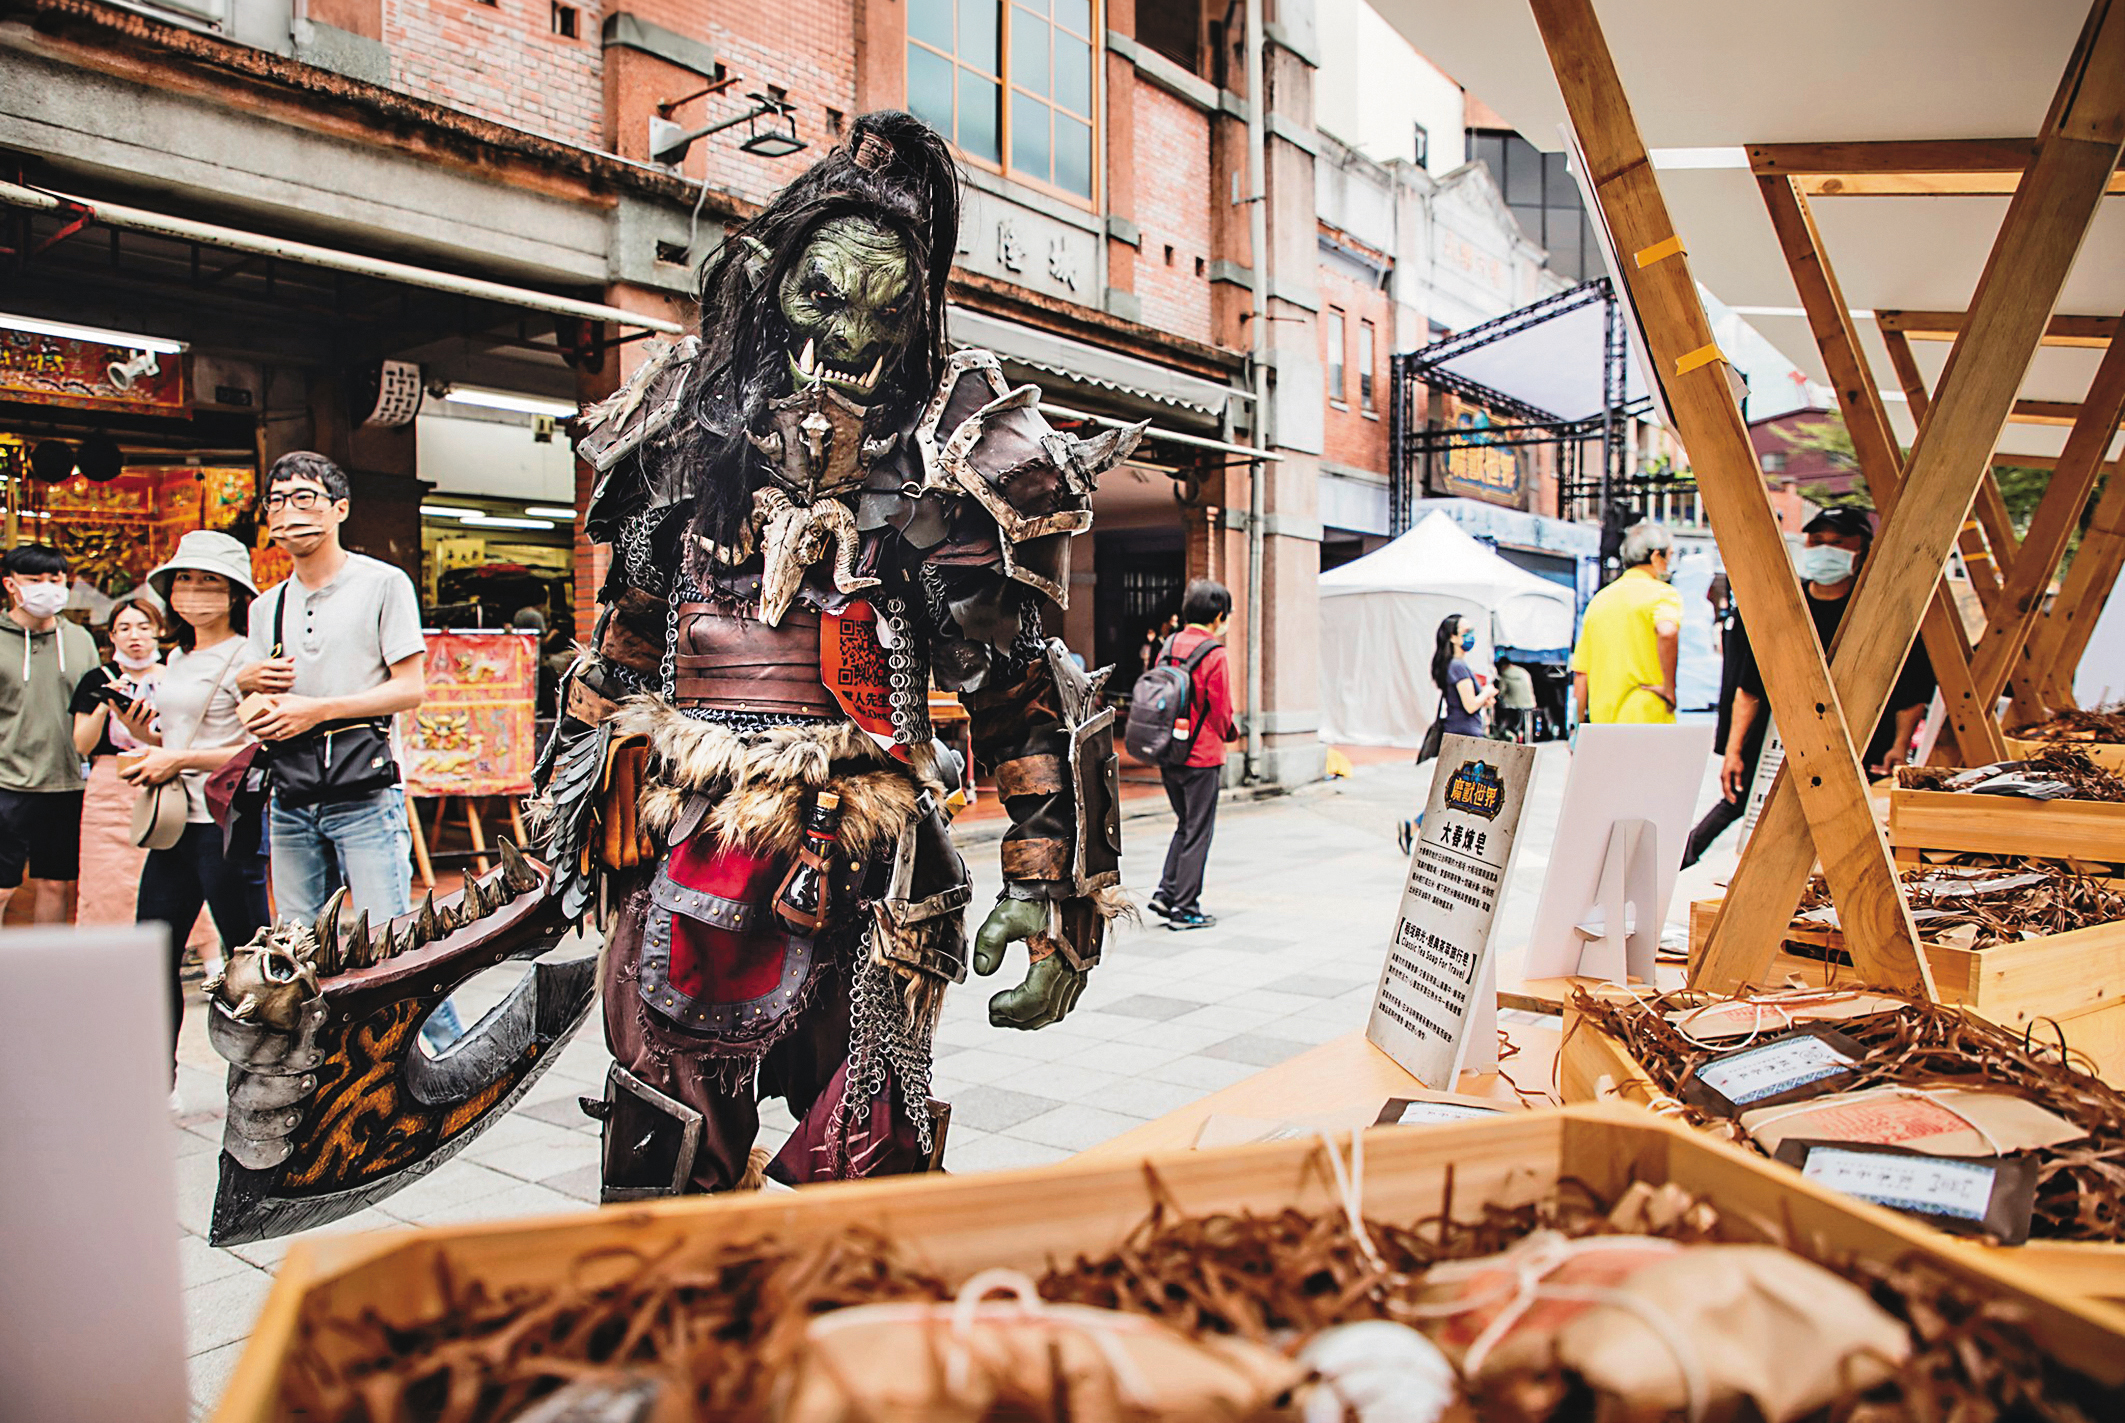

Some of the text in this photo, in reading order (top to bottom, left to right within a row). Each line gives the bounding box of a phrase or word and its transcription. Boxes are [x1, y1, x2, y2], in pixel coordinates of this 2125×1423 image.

[1450, 777, 1498, 808] 魔獸世界
[1440, 821, 1487, 856] 大春煉皂
[1401, 937, 1466, 979] Classic Tea Soap For Travel
